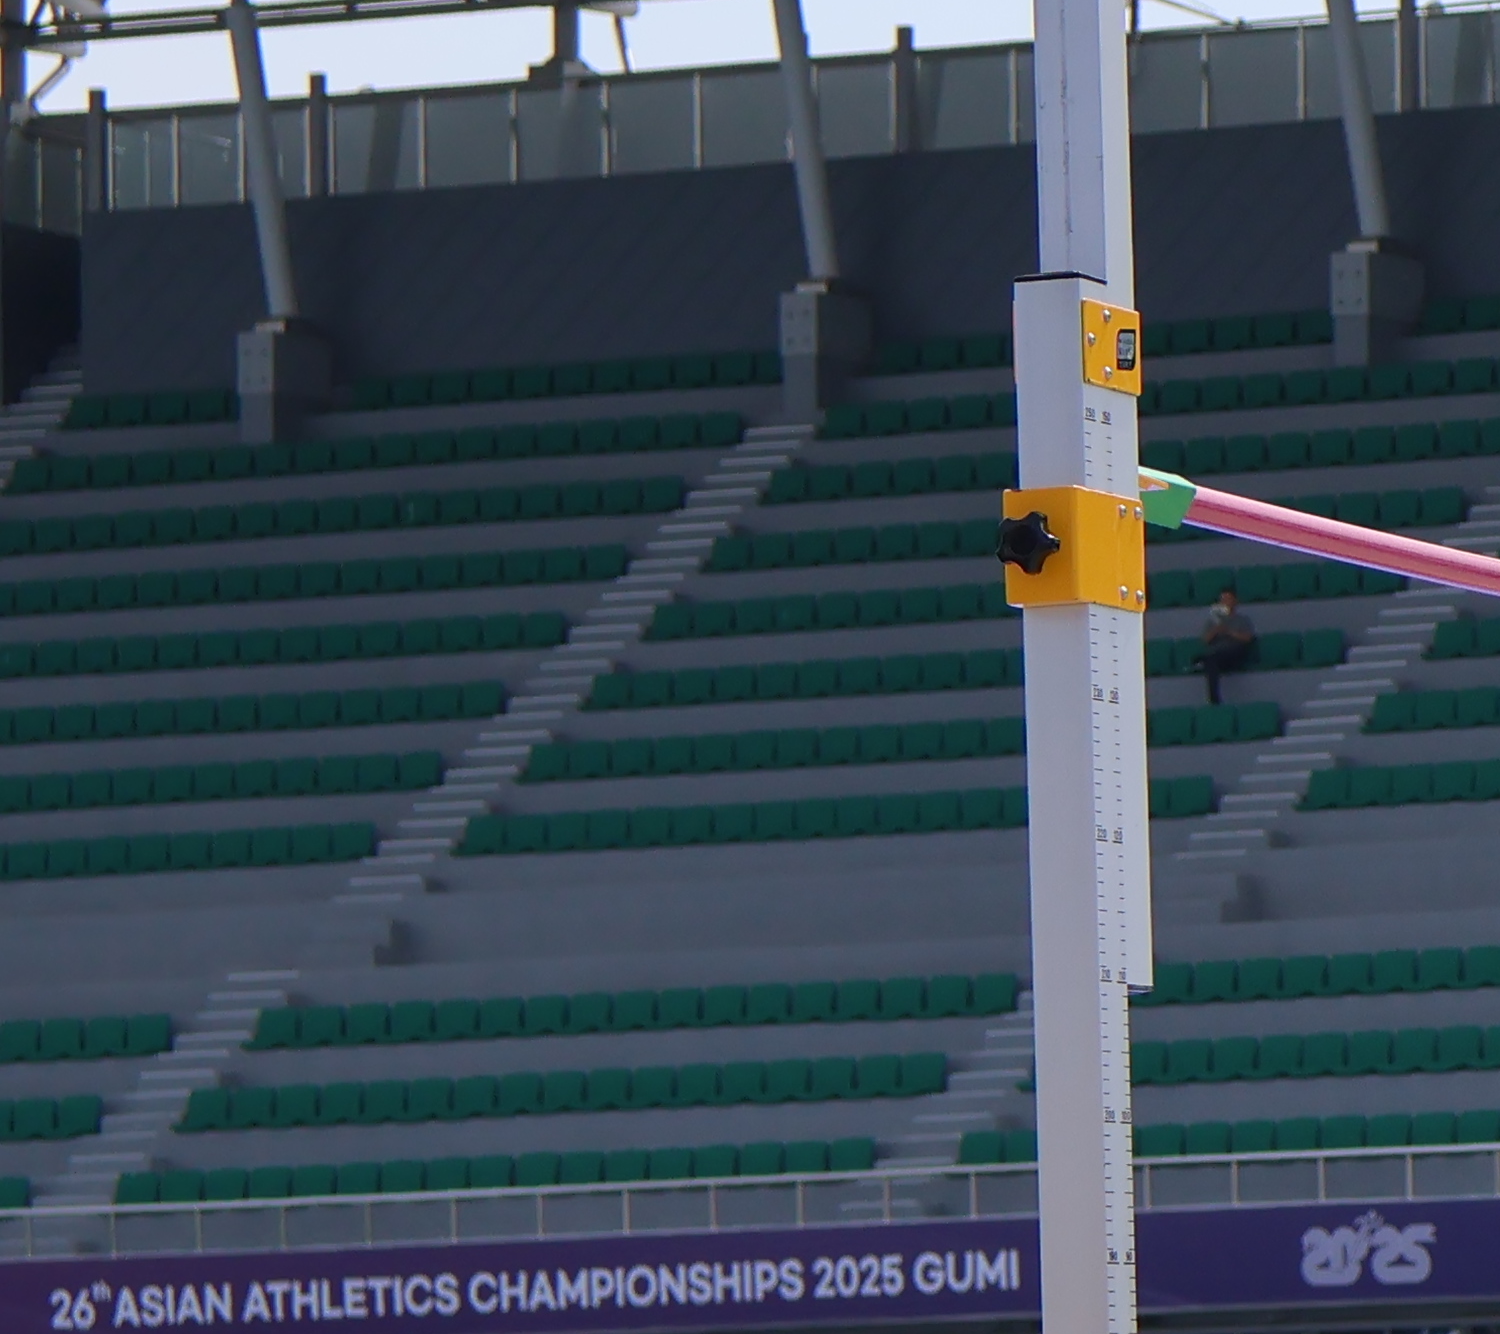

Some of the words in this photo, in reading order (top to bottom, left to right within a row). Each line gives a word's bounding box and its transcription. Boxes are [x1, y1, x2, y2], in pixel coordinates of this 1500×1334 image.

[113, 1282, 233, 1328] ASIAN
[243, 1268, 460, 1323] ATHLETICS
[468, 1257, 805, 1313] CHAMPIONSHIPS
[812, 1254, 904, 1298] 2025
[912, 1249, 1020, 1293] GUMI
